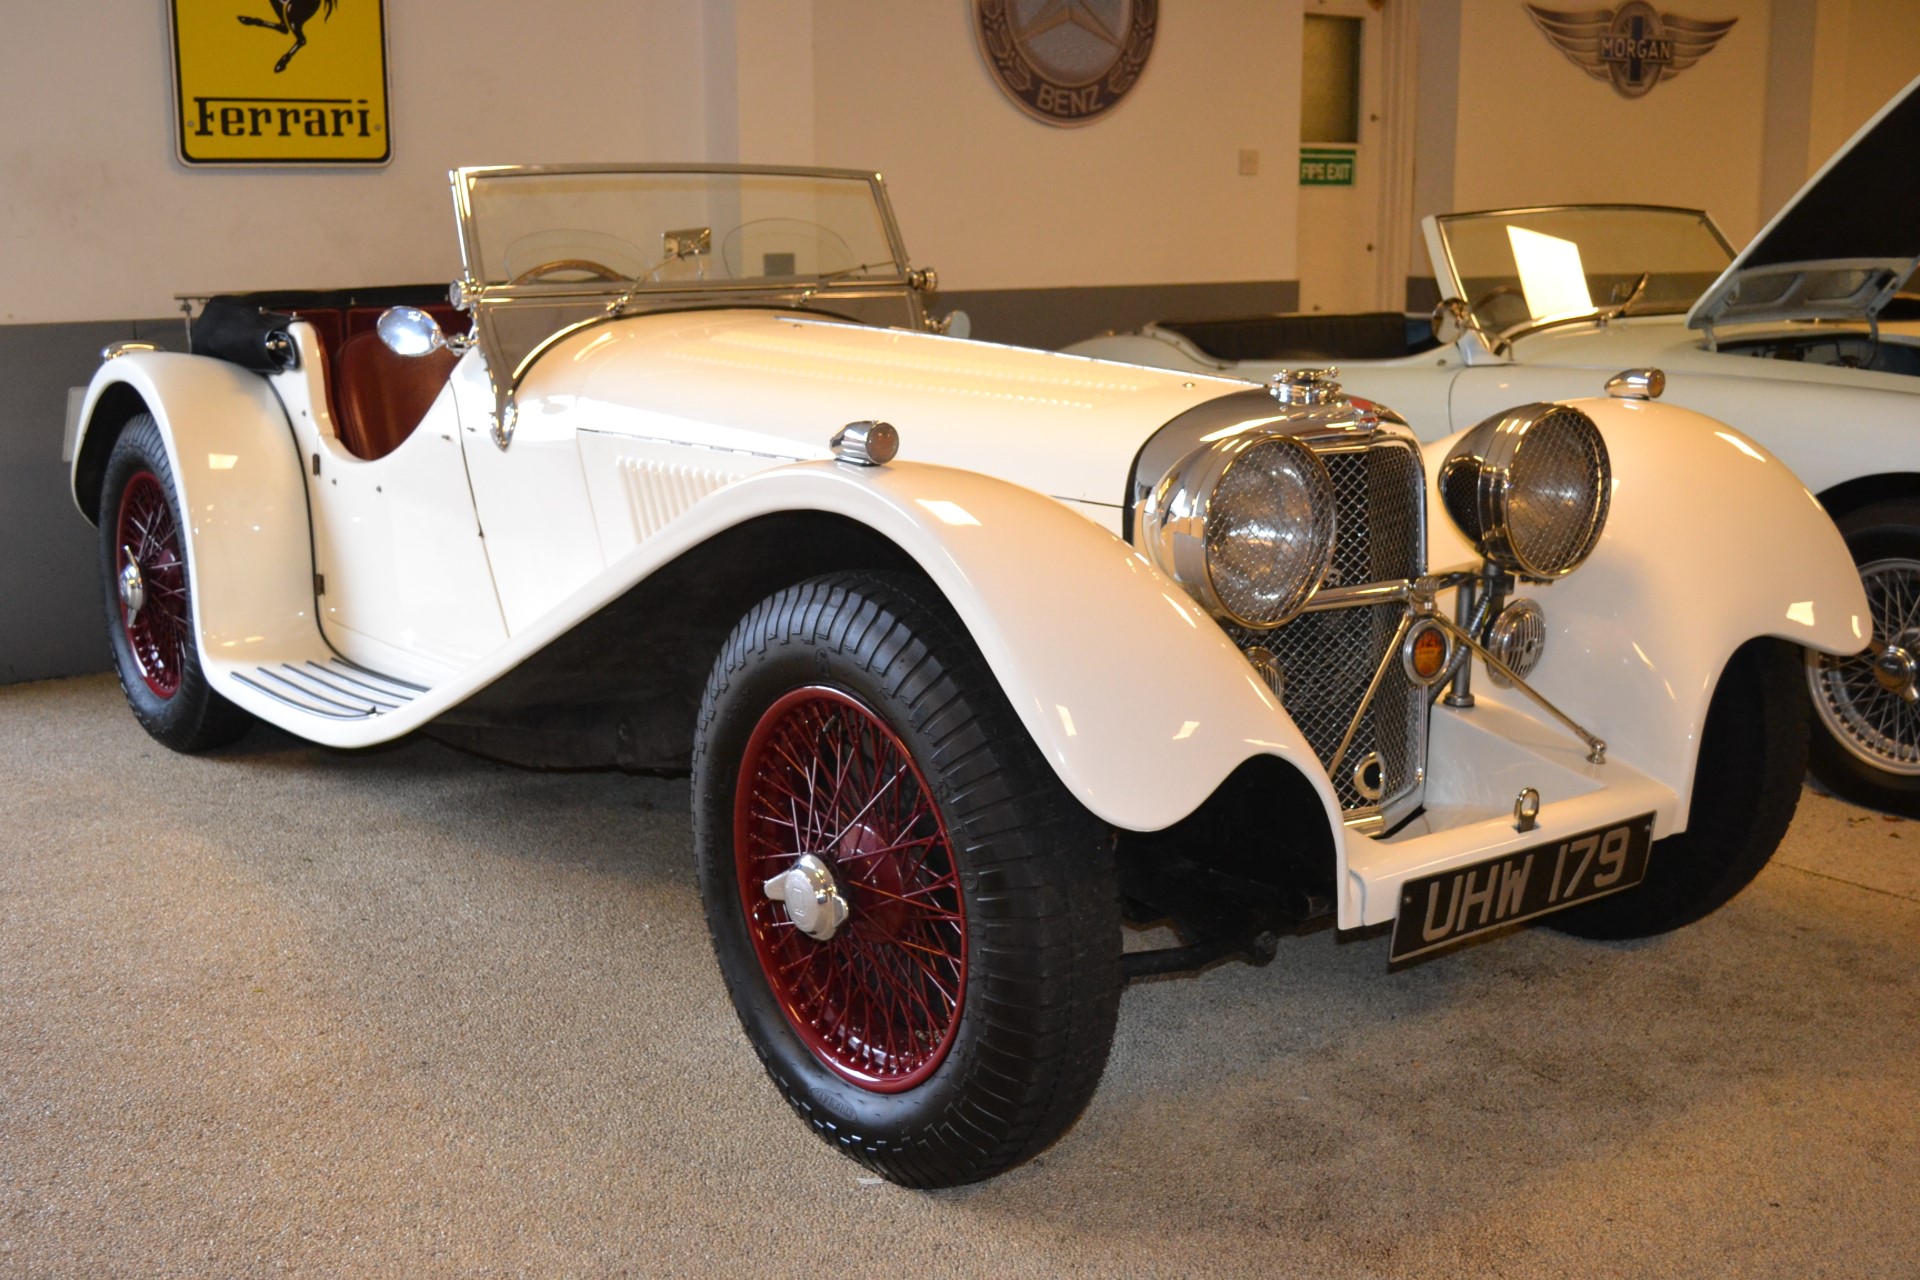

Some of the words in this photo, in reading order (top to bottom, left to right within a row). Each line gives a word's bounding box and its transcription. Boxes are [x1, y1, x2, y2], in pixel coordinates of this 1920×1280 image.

[1600, 38, 1671, 59] MORGAN
[193, 96, 371, 137] Ferrari
[1035, 82, 1104, 115] BENZ
[1422, 854, 1534, 942] UHW
[1548, 826, 1631, 902] 179
